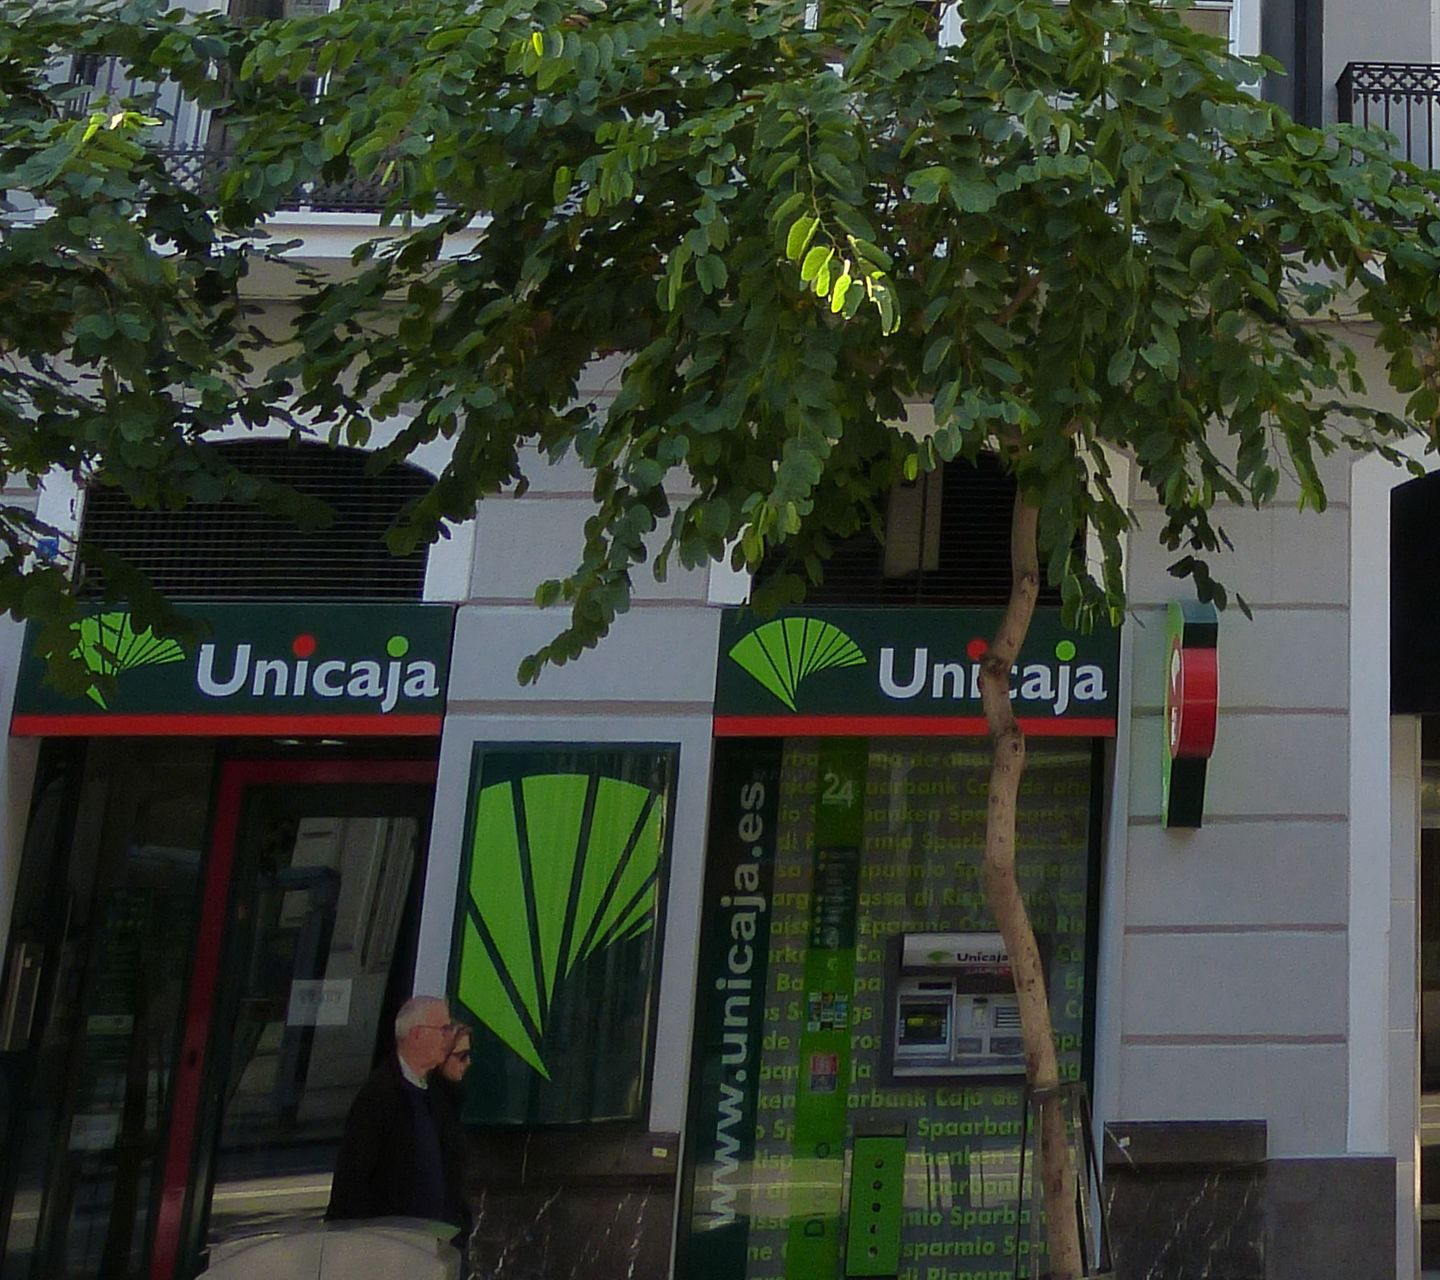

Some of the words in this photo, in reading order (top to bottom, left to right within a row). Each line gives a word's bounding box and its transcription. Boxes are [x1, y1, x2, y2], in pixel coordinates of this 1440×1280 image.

[197, 633, 439, 713] Unicaja
[879, 639, 1109, 716] Uniaja
[957, 951, 1009, 964] Unicaja
[711, 781, 765, 1231] www.unicaja.es
[847, 1092, 927, 1109] arbank
[935, 1088, 984, 1111] Caja
